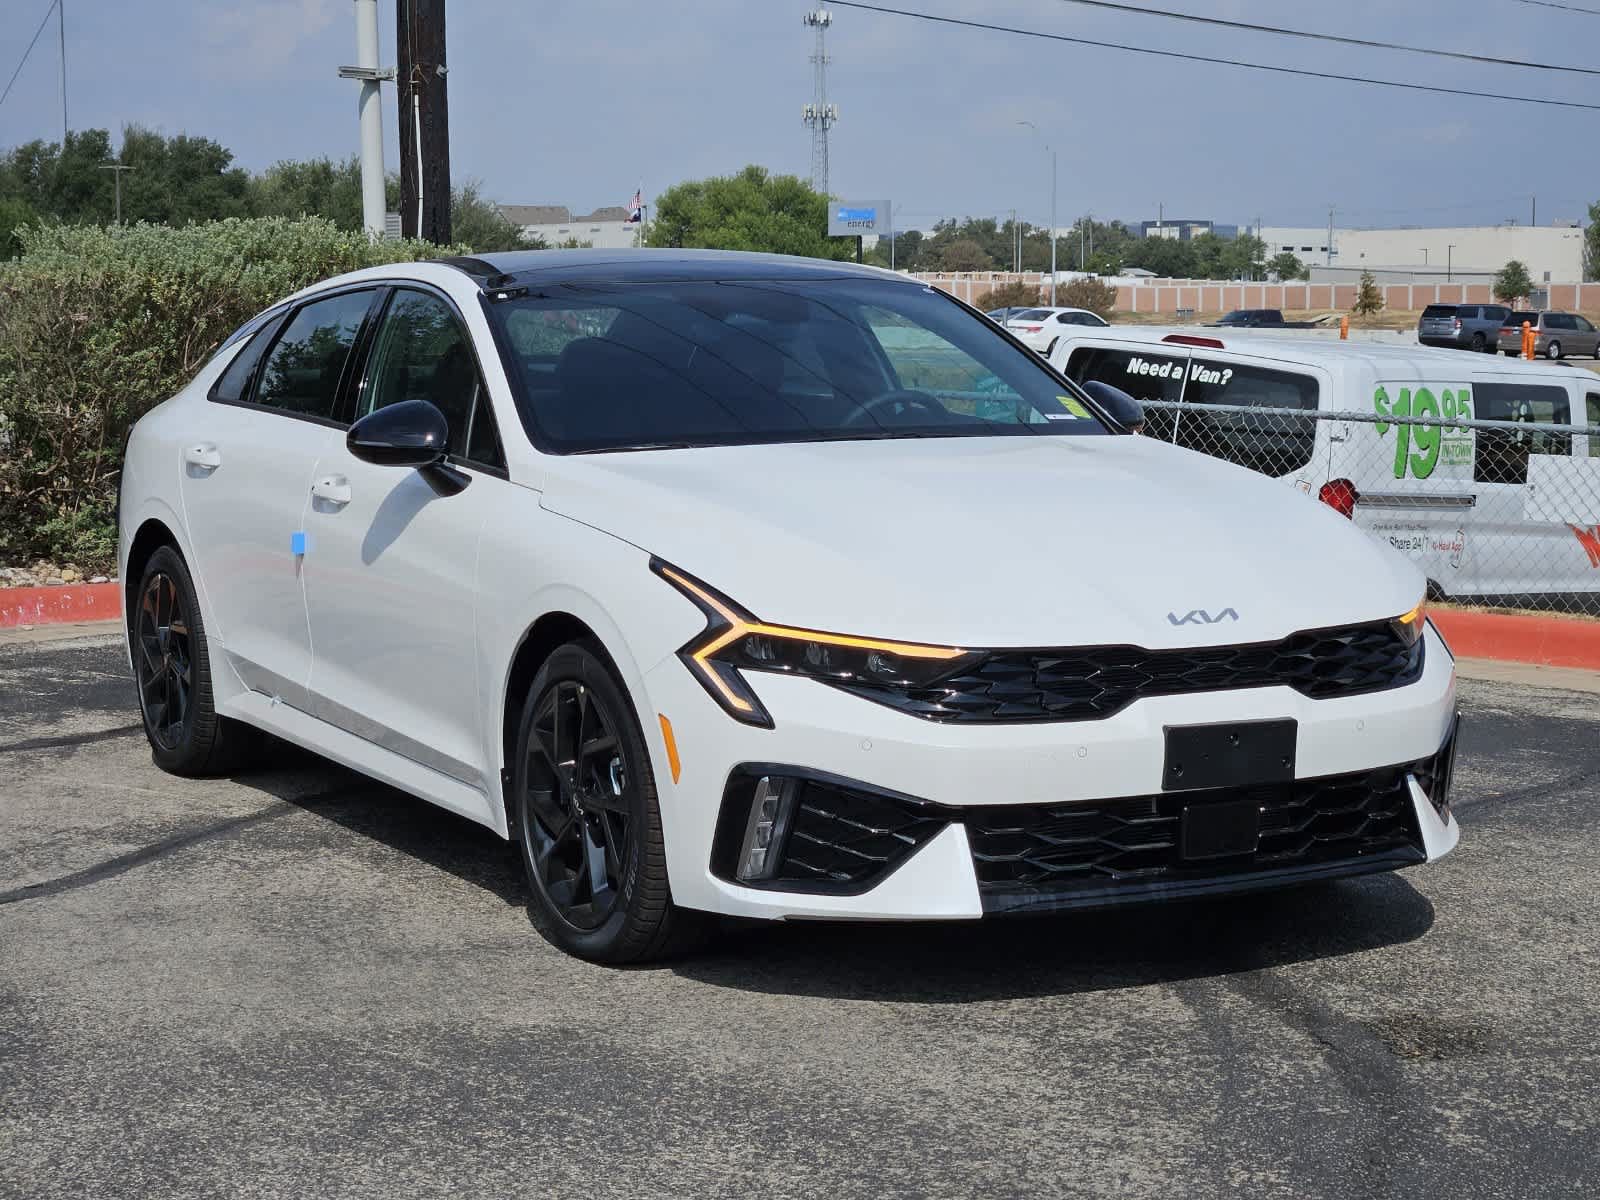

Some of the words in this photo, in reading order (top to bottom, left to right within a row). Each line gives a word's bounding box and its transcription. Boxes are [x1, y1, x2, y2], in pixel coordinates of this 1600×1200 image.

[1126, 357, 1173, 378] Need
[1171, 366, 1184, 380] a
[1190, 364, 1233, 385] Van?
[1389, 536, 1411, 550] Share
[1167, 608, 1239, 625] KIA
